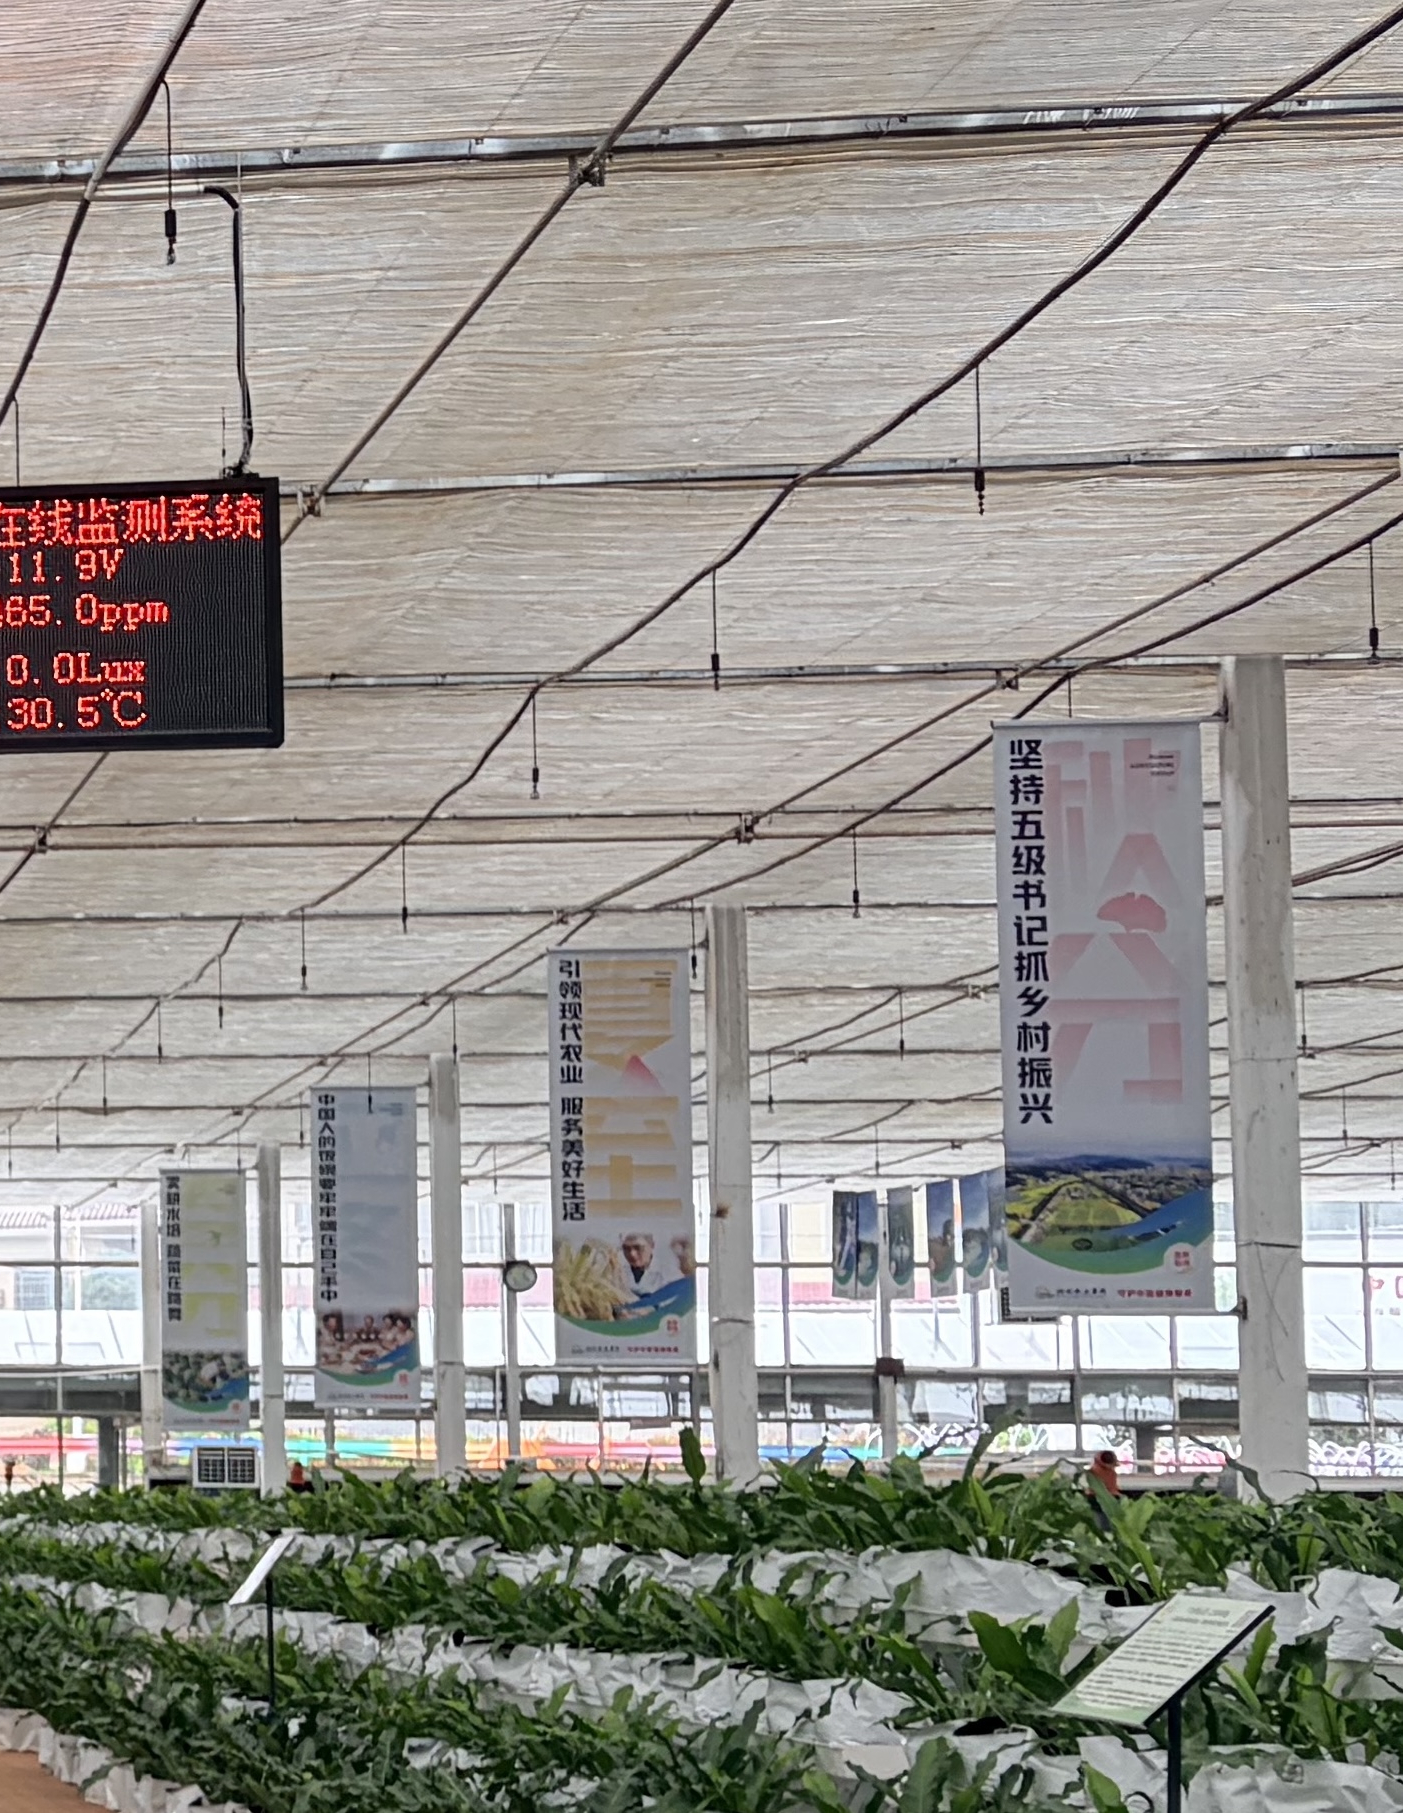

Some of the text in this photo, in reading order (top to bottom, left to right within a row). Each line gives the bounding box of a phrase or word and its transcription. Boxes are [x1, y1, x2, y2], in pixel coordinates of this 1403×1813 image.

[559, 959, 585, 1221] 引领现代农业 服务美好生活
[1009, 739, 1053, 1124] 坚持五级书记抓乡村振兴
